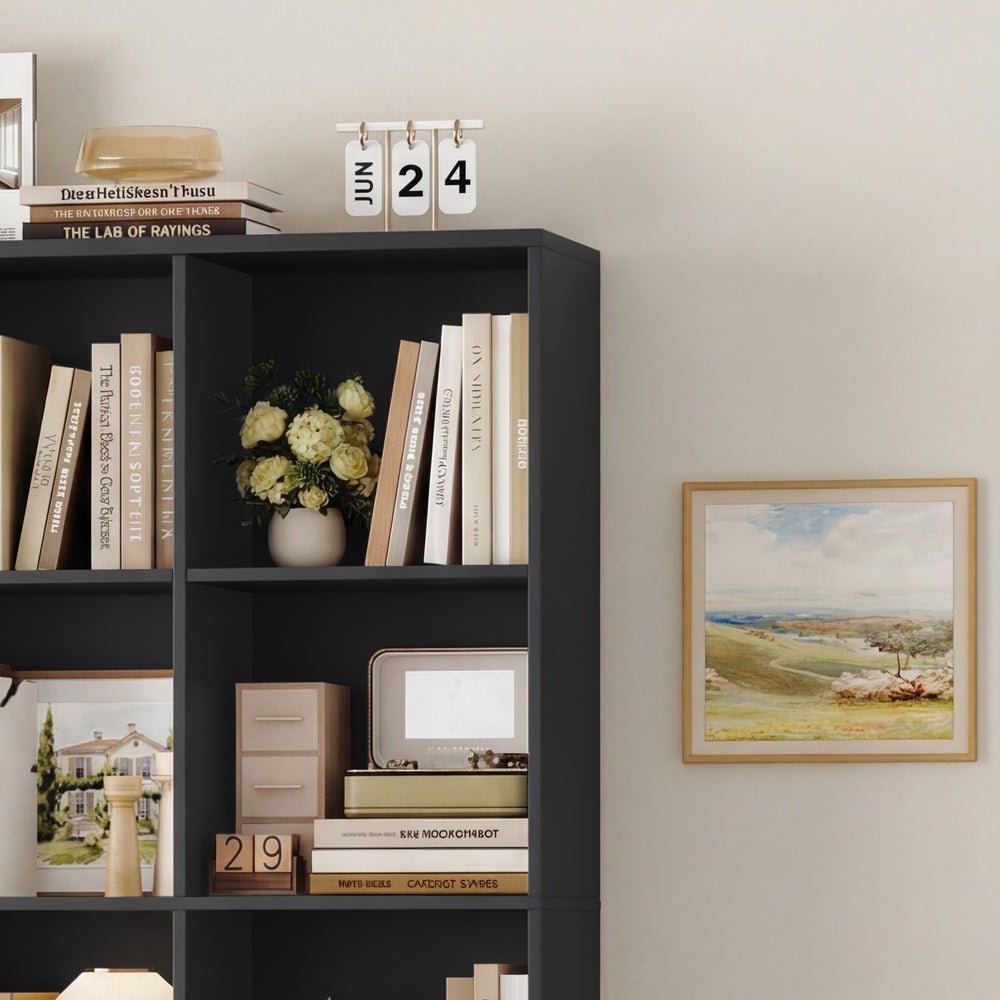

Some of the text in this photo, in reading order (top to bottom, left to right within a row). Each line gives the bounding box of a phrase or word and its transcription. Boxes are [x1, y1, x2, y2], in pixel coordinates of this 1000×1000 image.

[354, 162, 374, 205] JUN
[398, 164, 423, 197] 2
[444, 160, 471, 194] 4
[54, 209, 74, 218] THE
[64, 224, 212, 239] THE LAB OF RAYINGS
